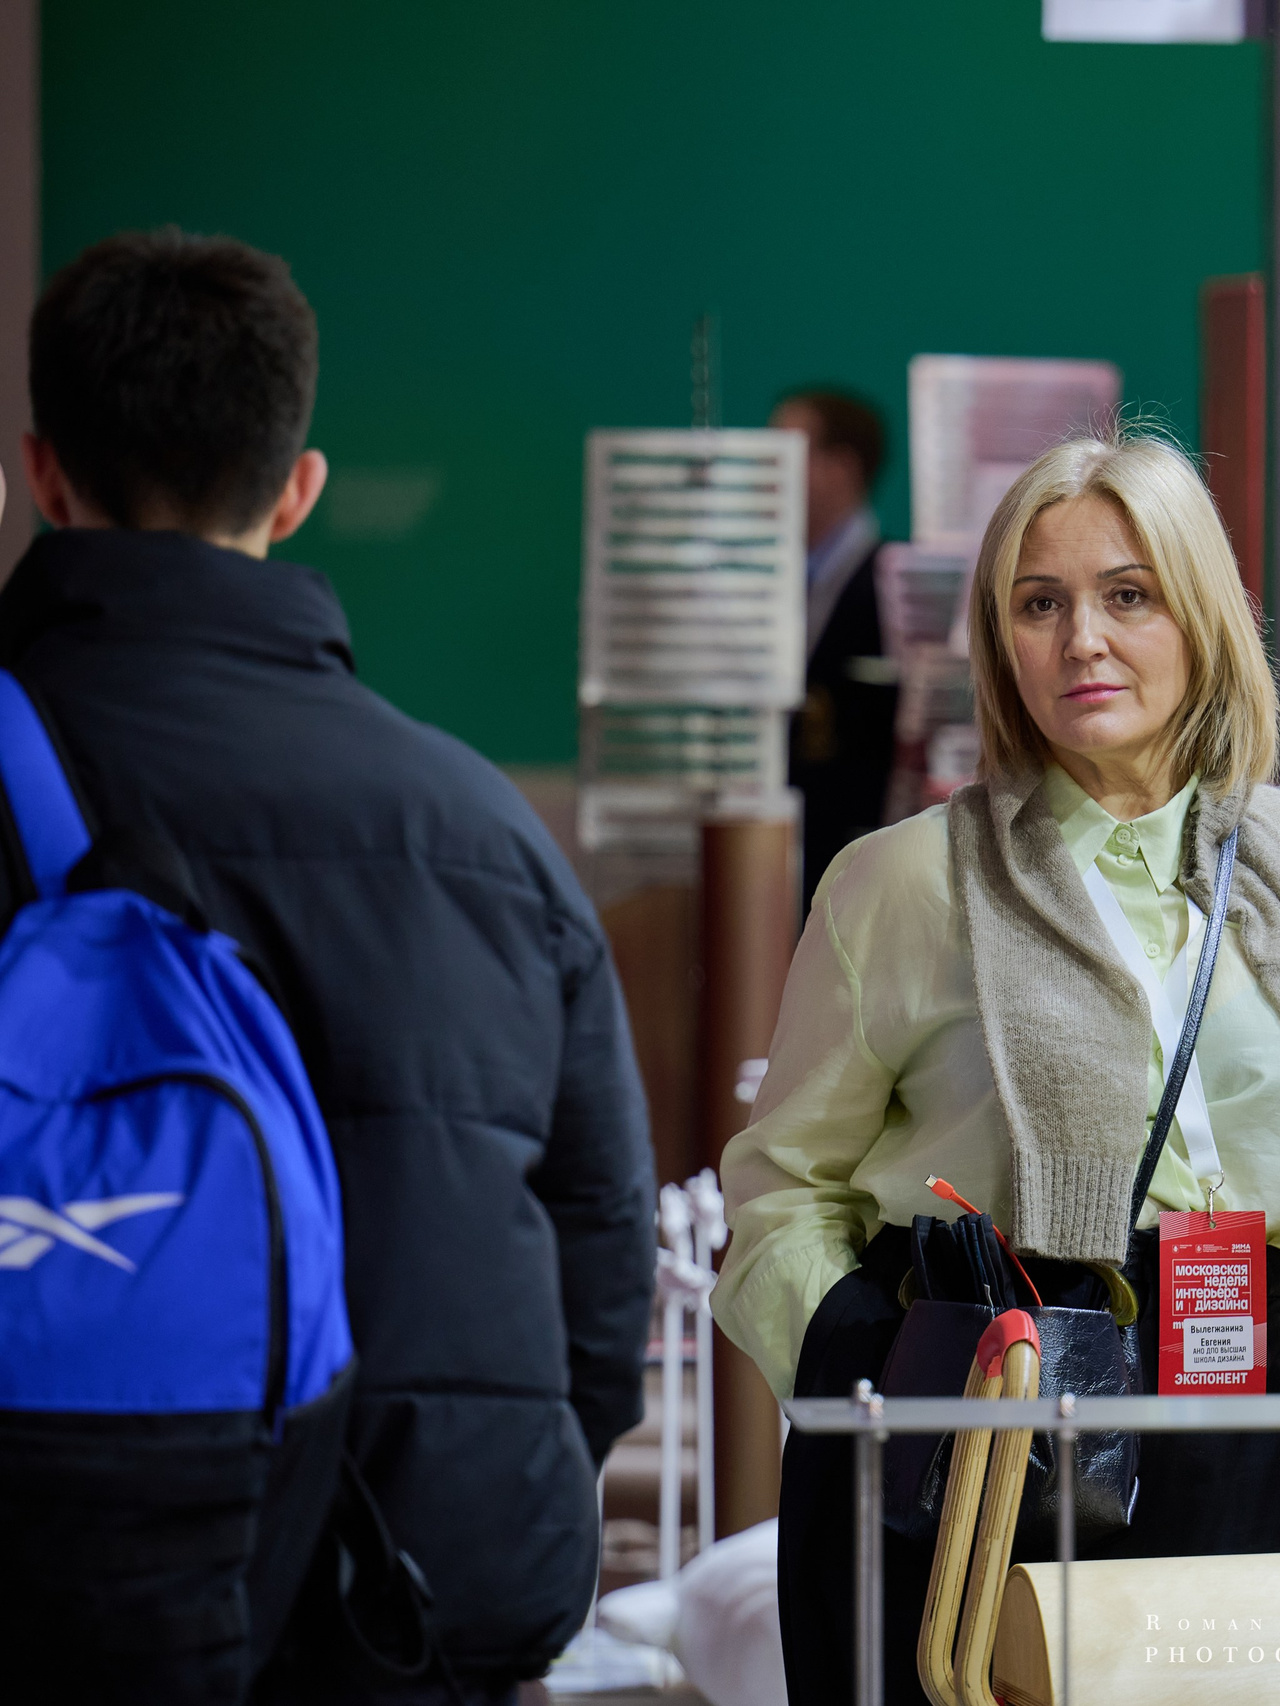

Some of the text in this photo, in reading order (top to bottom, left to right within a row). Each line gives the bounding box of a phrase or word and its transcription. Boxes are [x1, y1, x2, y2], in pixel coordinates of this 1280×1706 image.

[1175, 1264, 1248, 1276] московская
[1204, 1275, 1248, 1288] неделя
[1175, 1287, 1239, 1300] интерьера
[1175, 1298, 1248, 1312] и дизайна
[1190, 1325, 1244, 1333] Вылегжанина
[1200, 1338, 1231, 1346] Евгения
[1217, 1354, 1245, 1363] ДИЗАЙНА
[1174, 1372, 1248, 1385] ЭКСПОНЕНТ
